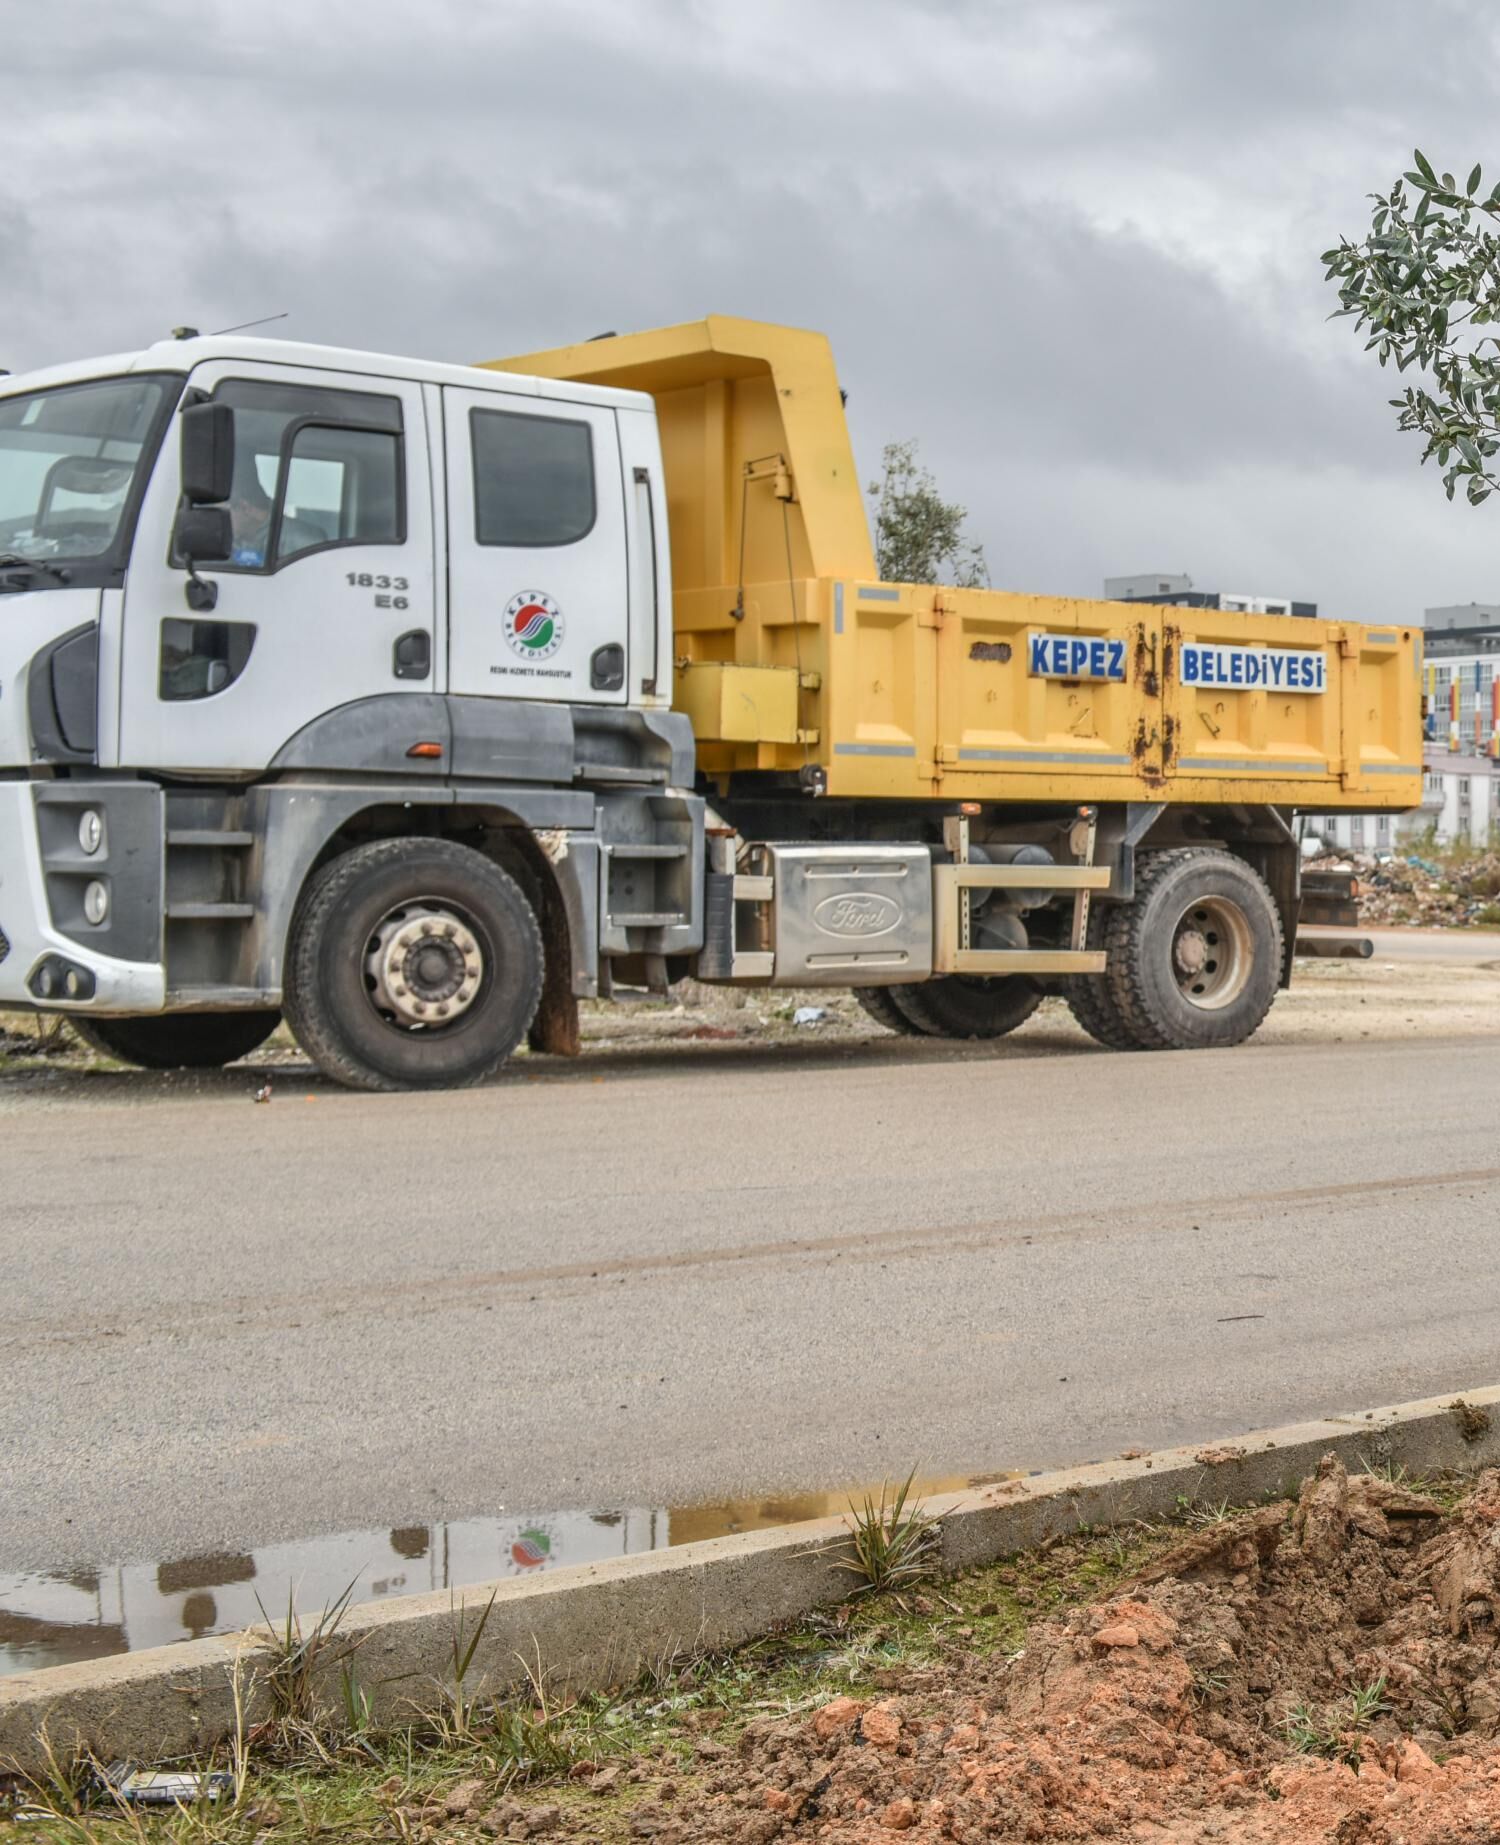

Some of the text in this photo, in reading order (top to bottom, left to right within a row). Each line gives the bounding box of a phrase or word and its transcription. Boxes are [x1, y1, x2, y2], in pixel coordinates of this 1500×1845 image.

[346, 572, 409, 591] 1833
[374, 594, 409, 610] E6
[1032, 639, 1124, 677] KEPEZ
[832, 901, 885, 928] Ford
